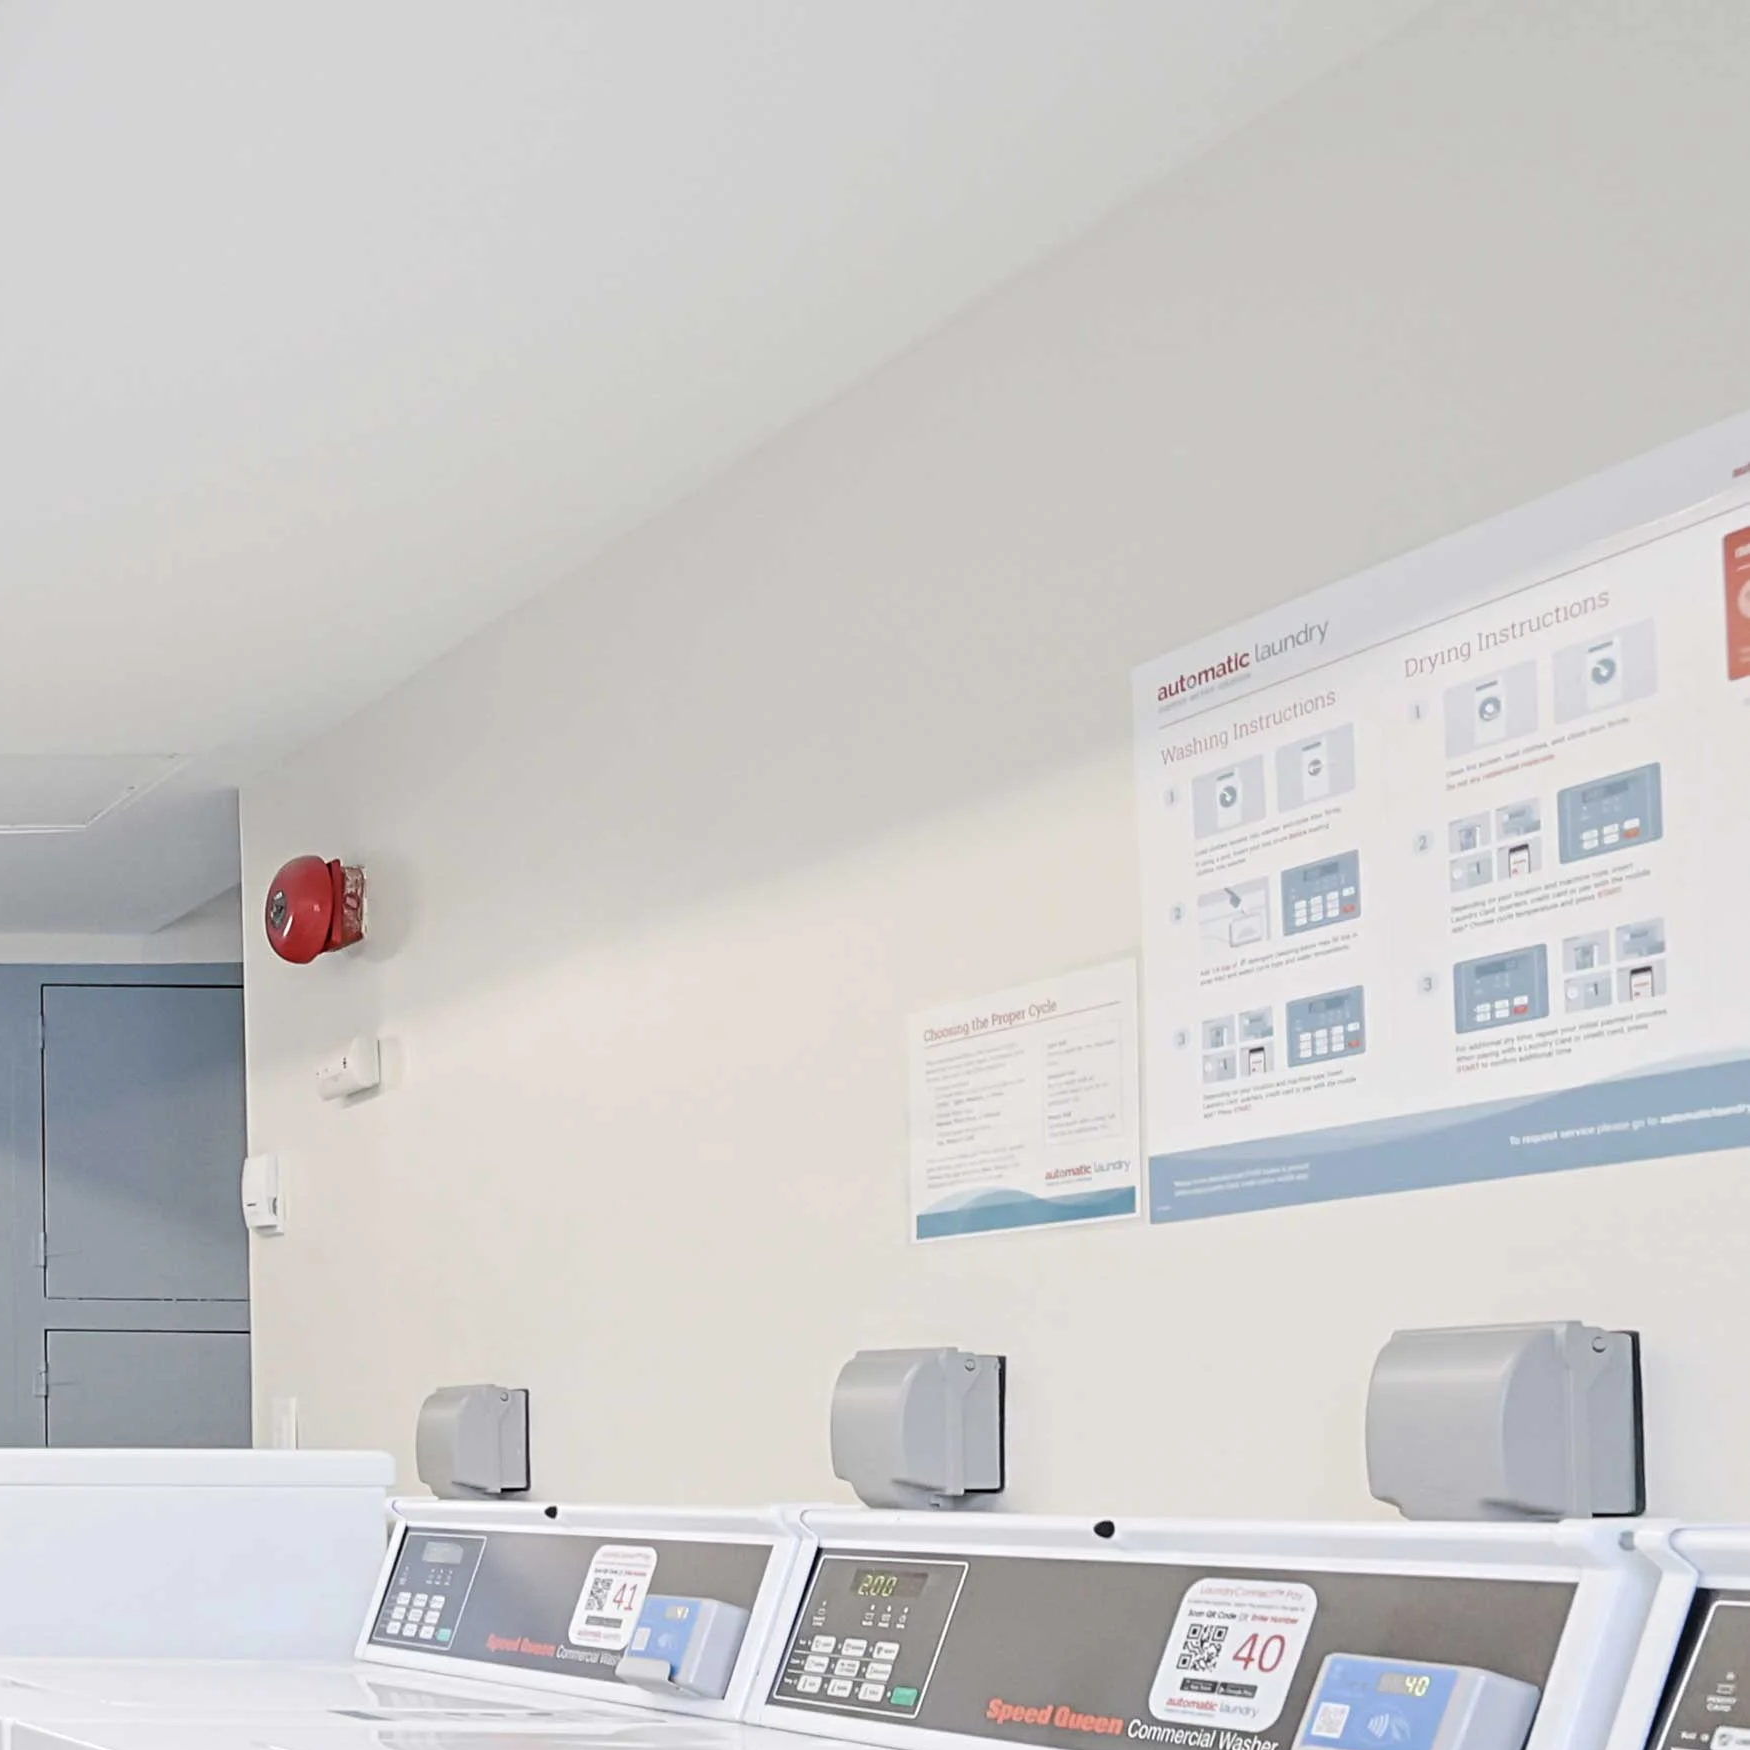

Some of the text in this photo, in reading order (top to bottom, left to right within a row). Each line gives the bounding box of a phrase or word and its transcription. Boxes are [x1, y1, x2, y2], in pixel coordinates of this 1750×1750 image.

[1404, 590, 1610, 678] Drying Instructions
[1158, 652, 1250, 701] automatic
[1254, 620, 1329, 663] laundry
[1161, 729, 1229, 765] Washing
[1233, 690, 1336, 741] Instructions
[923, 999, 1057, 1042] Choosing the Proper Cycle
[1045, 1159, 1131, 1181] automatic laundry
[612, 1582, 638, 1611] 41
[1218, 1611, 1237, 1620] Code
[556, 1644, 599, 1664] Commercial
[1232, 1632, 1286, 1673] 40
[1404, 1675, 1430, 1697] 40
[986, 1697, 1053, 1725] Speed
[1053, 1707, 1124, 1736] Queen
[1127, 1718, 1214, 1748] Commercial
[1165, 1697, 1260, 1718] automatic laundry
